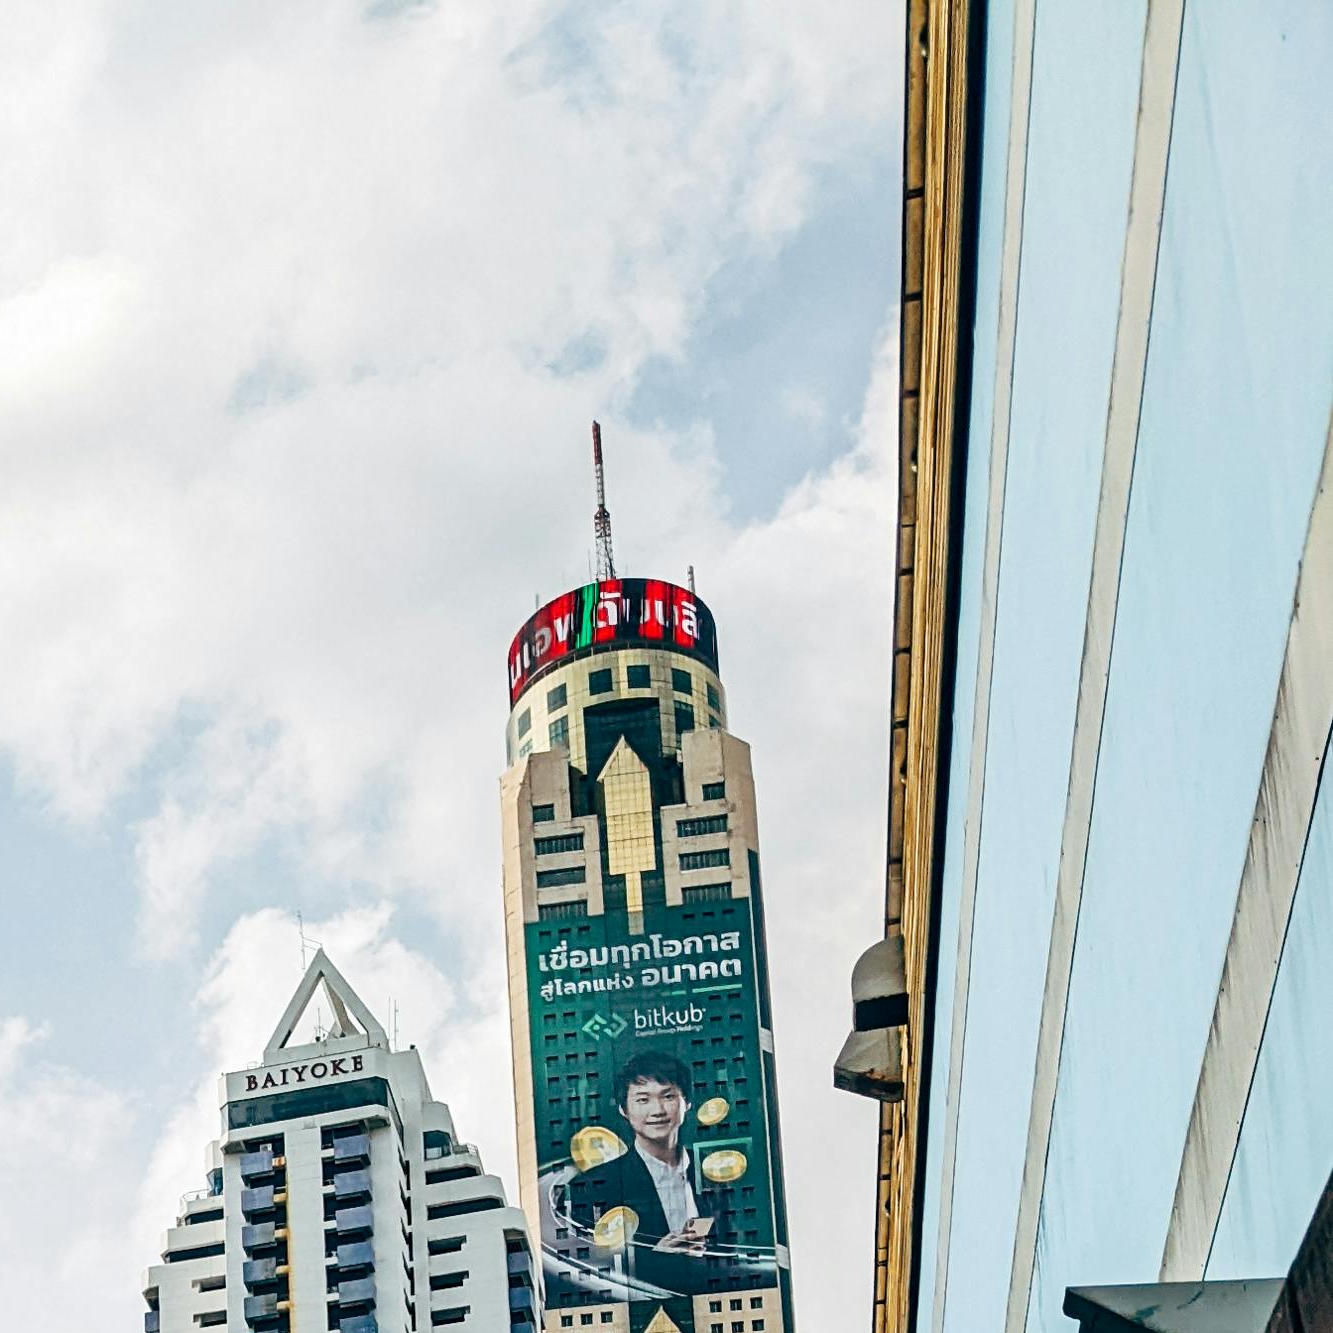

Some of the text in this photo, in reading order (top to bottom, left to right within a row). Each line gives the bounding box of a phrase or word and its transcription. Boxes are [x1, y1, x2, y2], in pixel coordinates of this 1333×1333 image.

[538, 931, 740, 972] เชื่อมทุกโอกาส
[540, 958, 742, 1002] สู่โลกแห่ง อนาคต
[634, 1002, 704, 1029] bitkub
[245, 1054, 364, 1092] BAIYOKE
